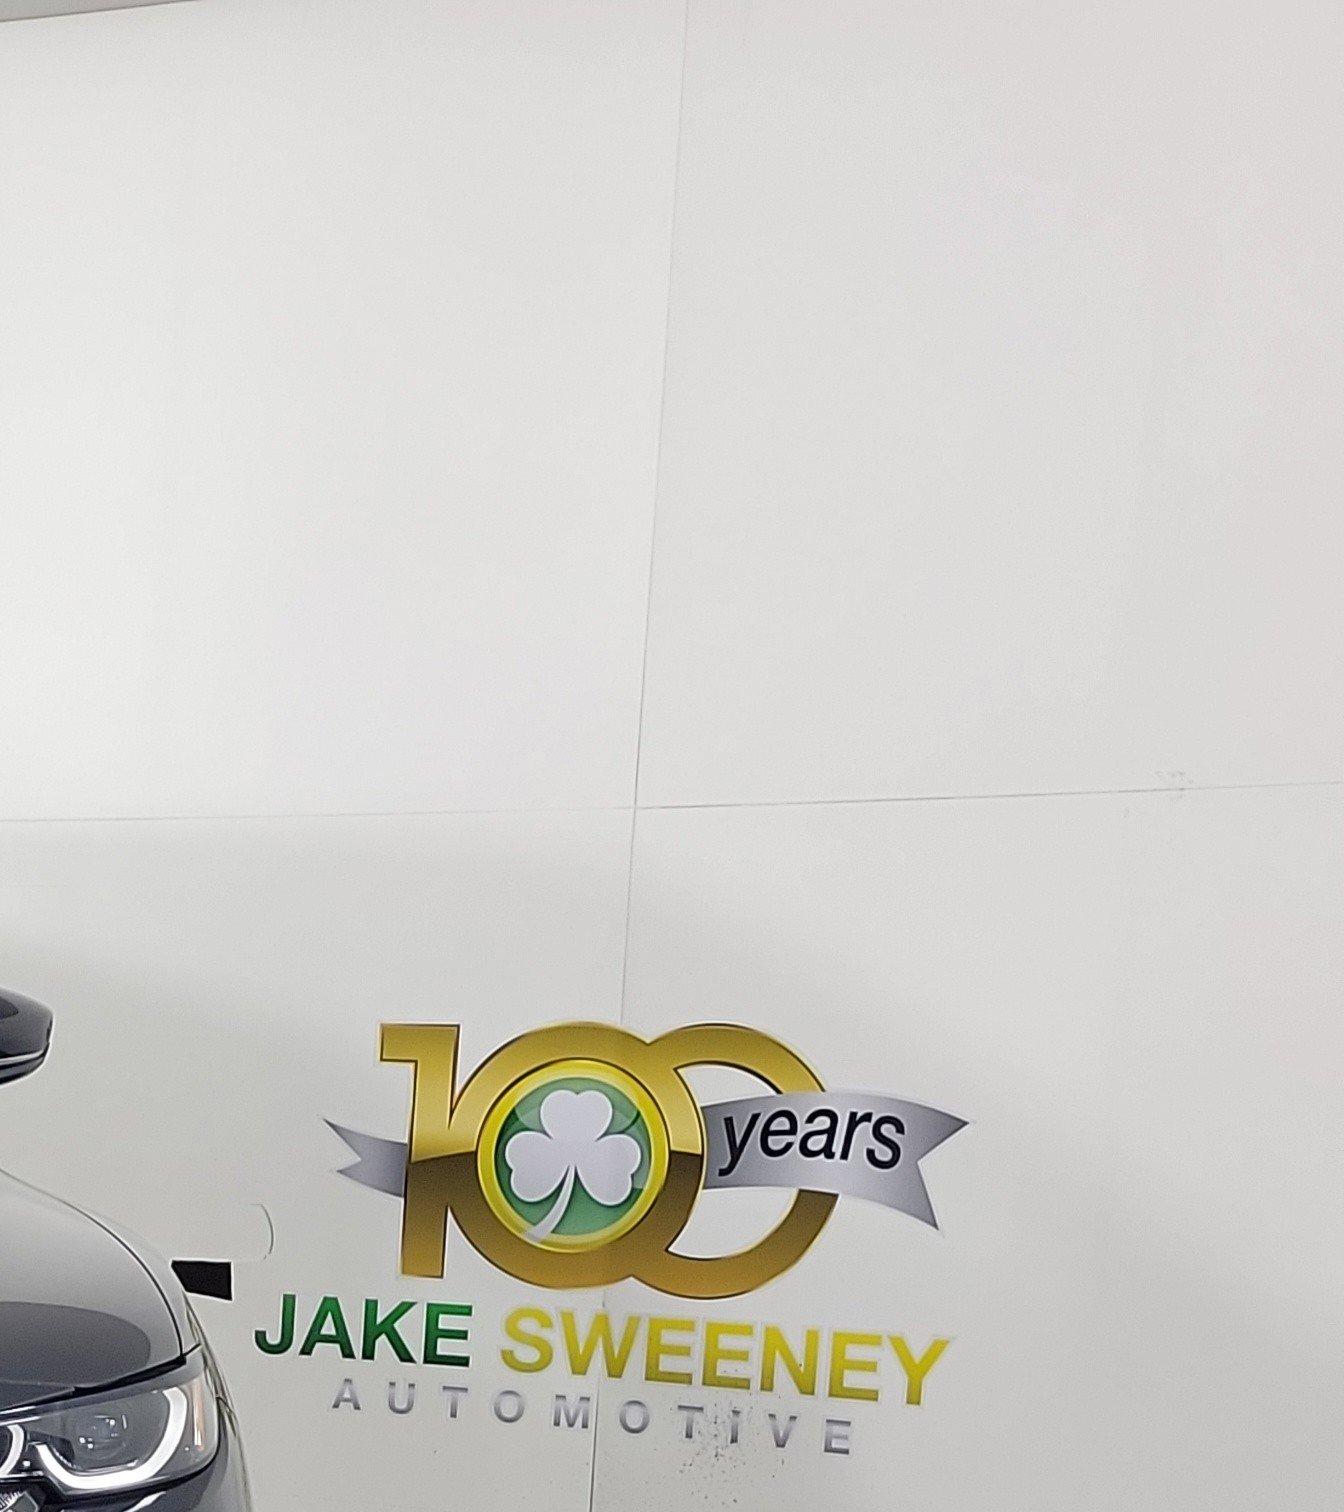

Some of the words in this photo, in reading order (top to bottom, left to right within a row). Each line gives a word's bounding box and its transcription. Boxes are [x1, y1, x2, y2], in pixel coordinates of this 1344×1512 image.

[719, 1107, 906, 1177] years
[254, 1293, 473, 1367] JAKE
[500, 1307, 951, 1406] SWEENEY
[332, 1378, 852, 1455] AUTOMOTIVE
